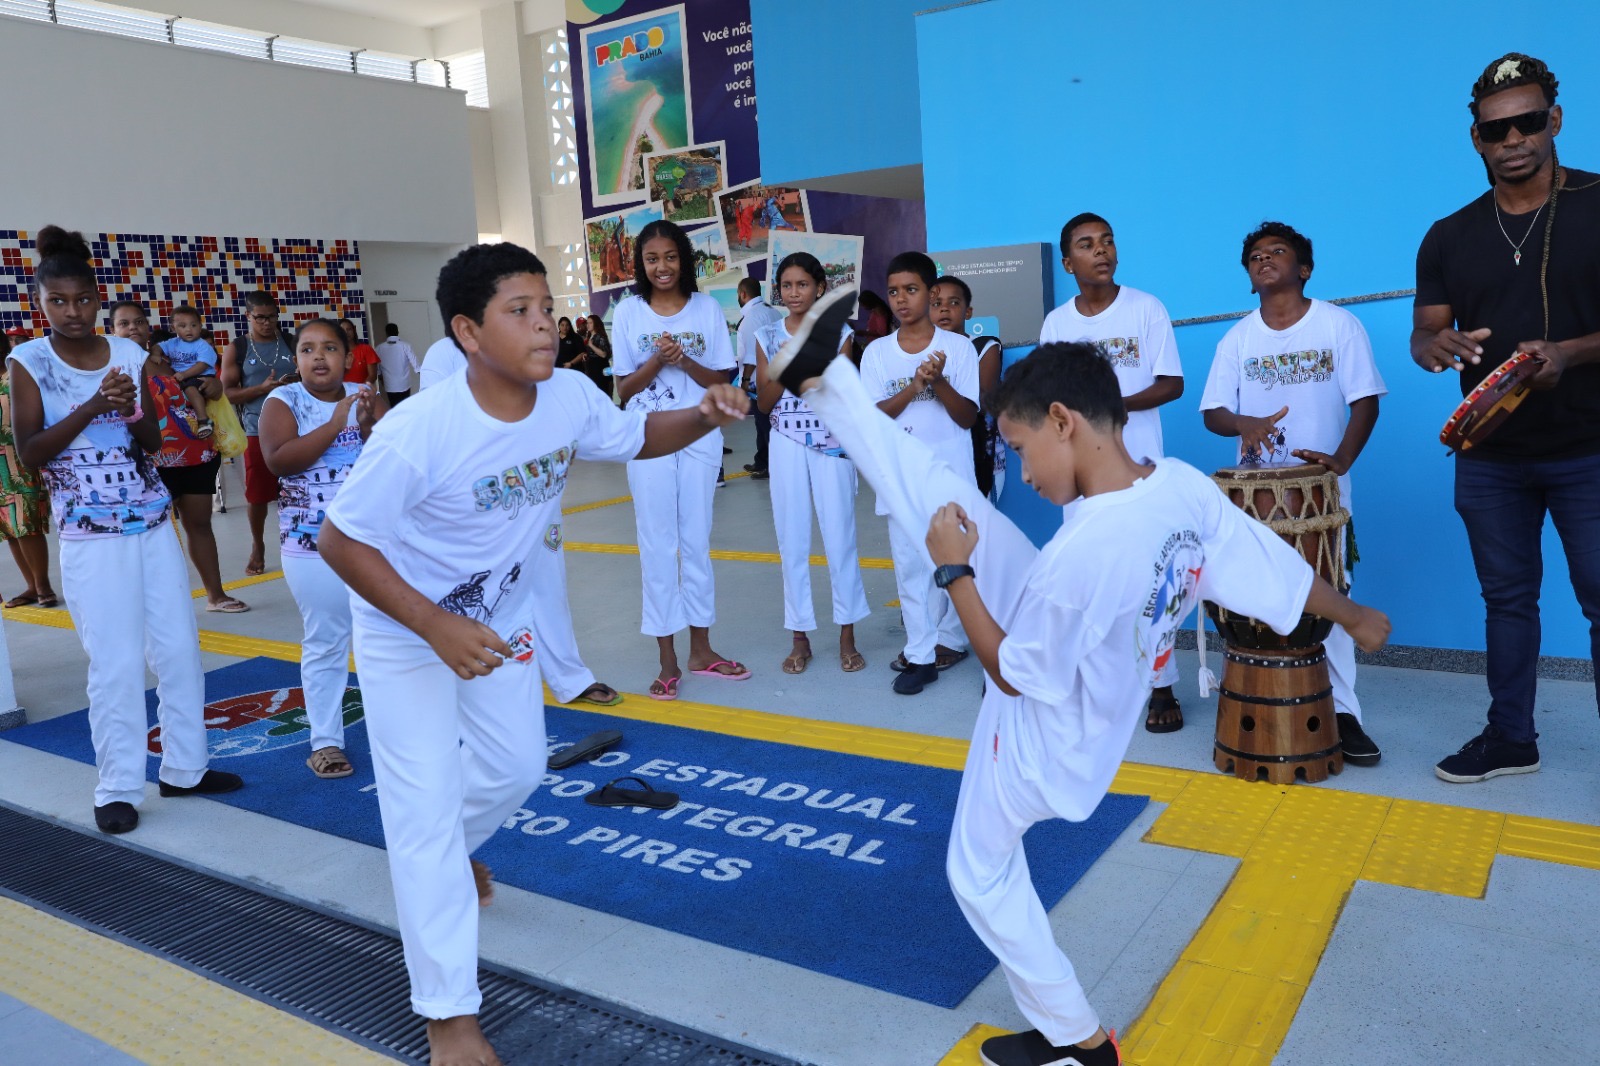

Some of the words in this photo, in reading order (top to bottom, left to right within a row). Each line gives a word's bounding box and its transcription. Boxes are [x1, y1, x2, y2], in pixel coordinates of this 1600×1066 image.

[702, 26, 729, 43] Você
[594, 26, 665, 68] PRADO
[639, 47, 663, 62] BAHIA
[725, 40, 752, 56] você
[725, 75, 752, 92] você
[733, 95, 741, 108] é
[630, 758, 917, 826] ESTADUAL
[566, 826, 753, 882] PIRES
